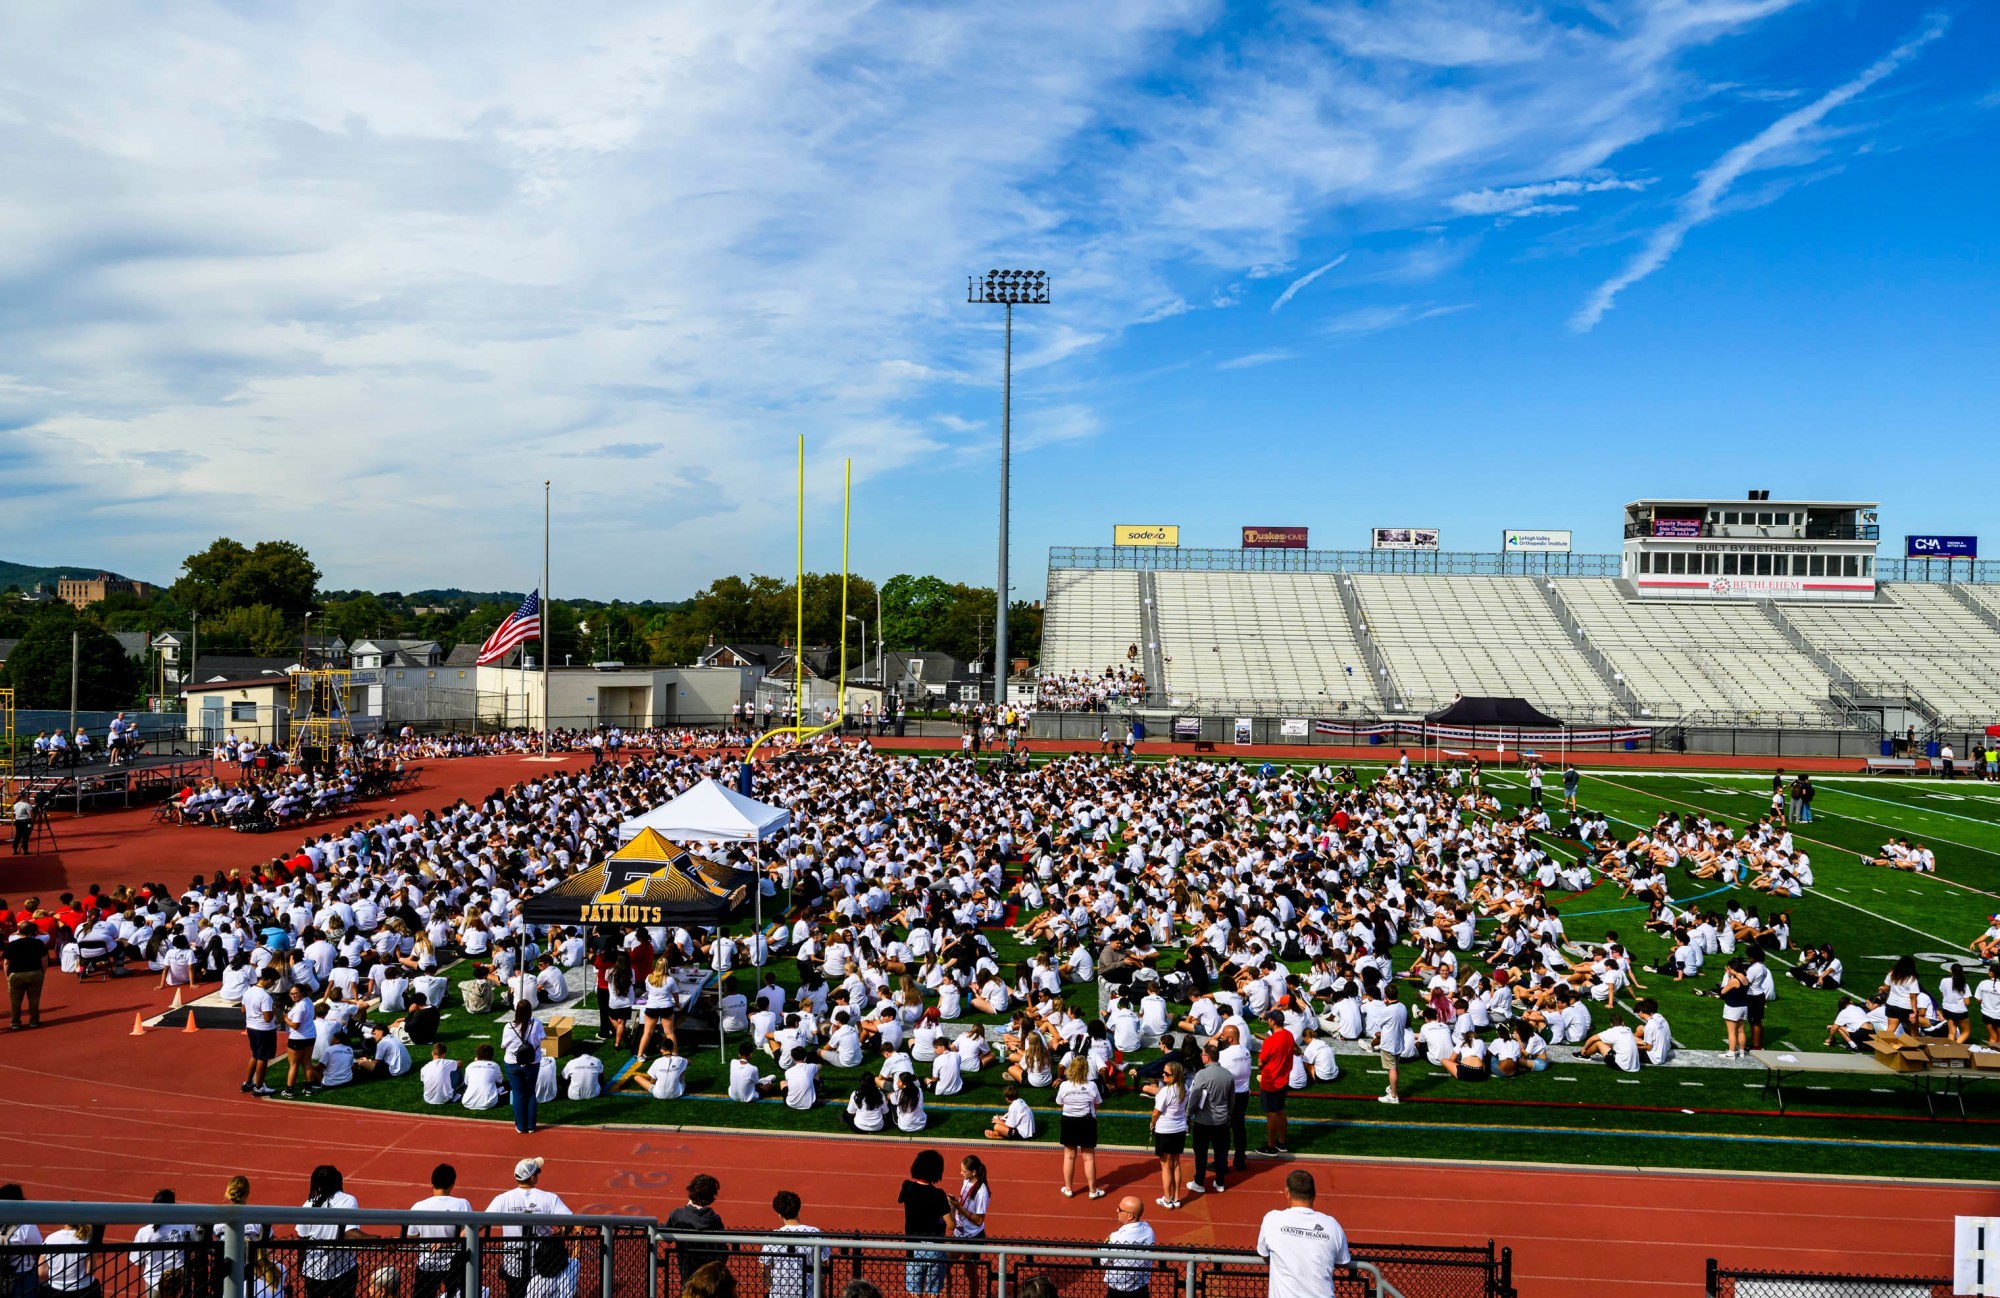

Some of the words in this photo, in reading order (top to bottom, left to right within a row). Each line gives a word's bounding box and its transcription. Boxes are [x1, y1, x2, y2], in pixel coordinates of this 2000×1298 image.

[1128, 528, 1166, 540] sodexo
[1696, 544, 1727, 552] BUILT
[1730, 544, 1746, 552] BY
[1748, 545, 1817, 553] BETHLEHEM
[1915, 539, 1941, 549] CHA
[1733, 580, 1799, 590] BETHLEHEM
[590, 859, 671, 905] F
[580, 904, 662, 923] PATRIOTS
[1280, 1227, 1304, 1236] COUNTRY
[1305, 1231, 1330, 1240] MEADOWS
